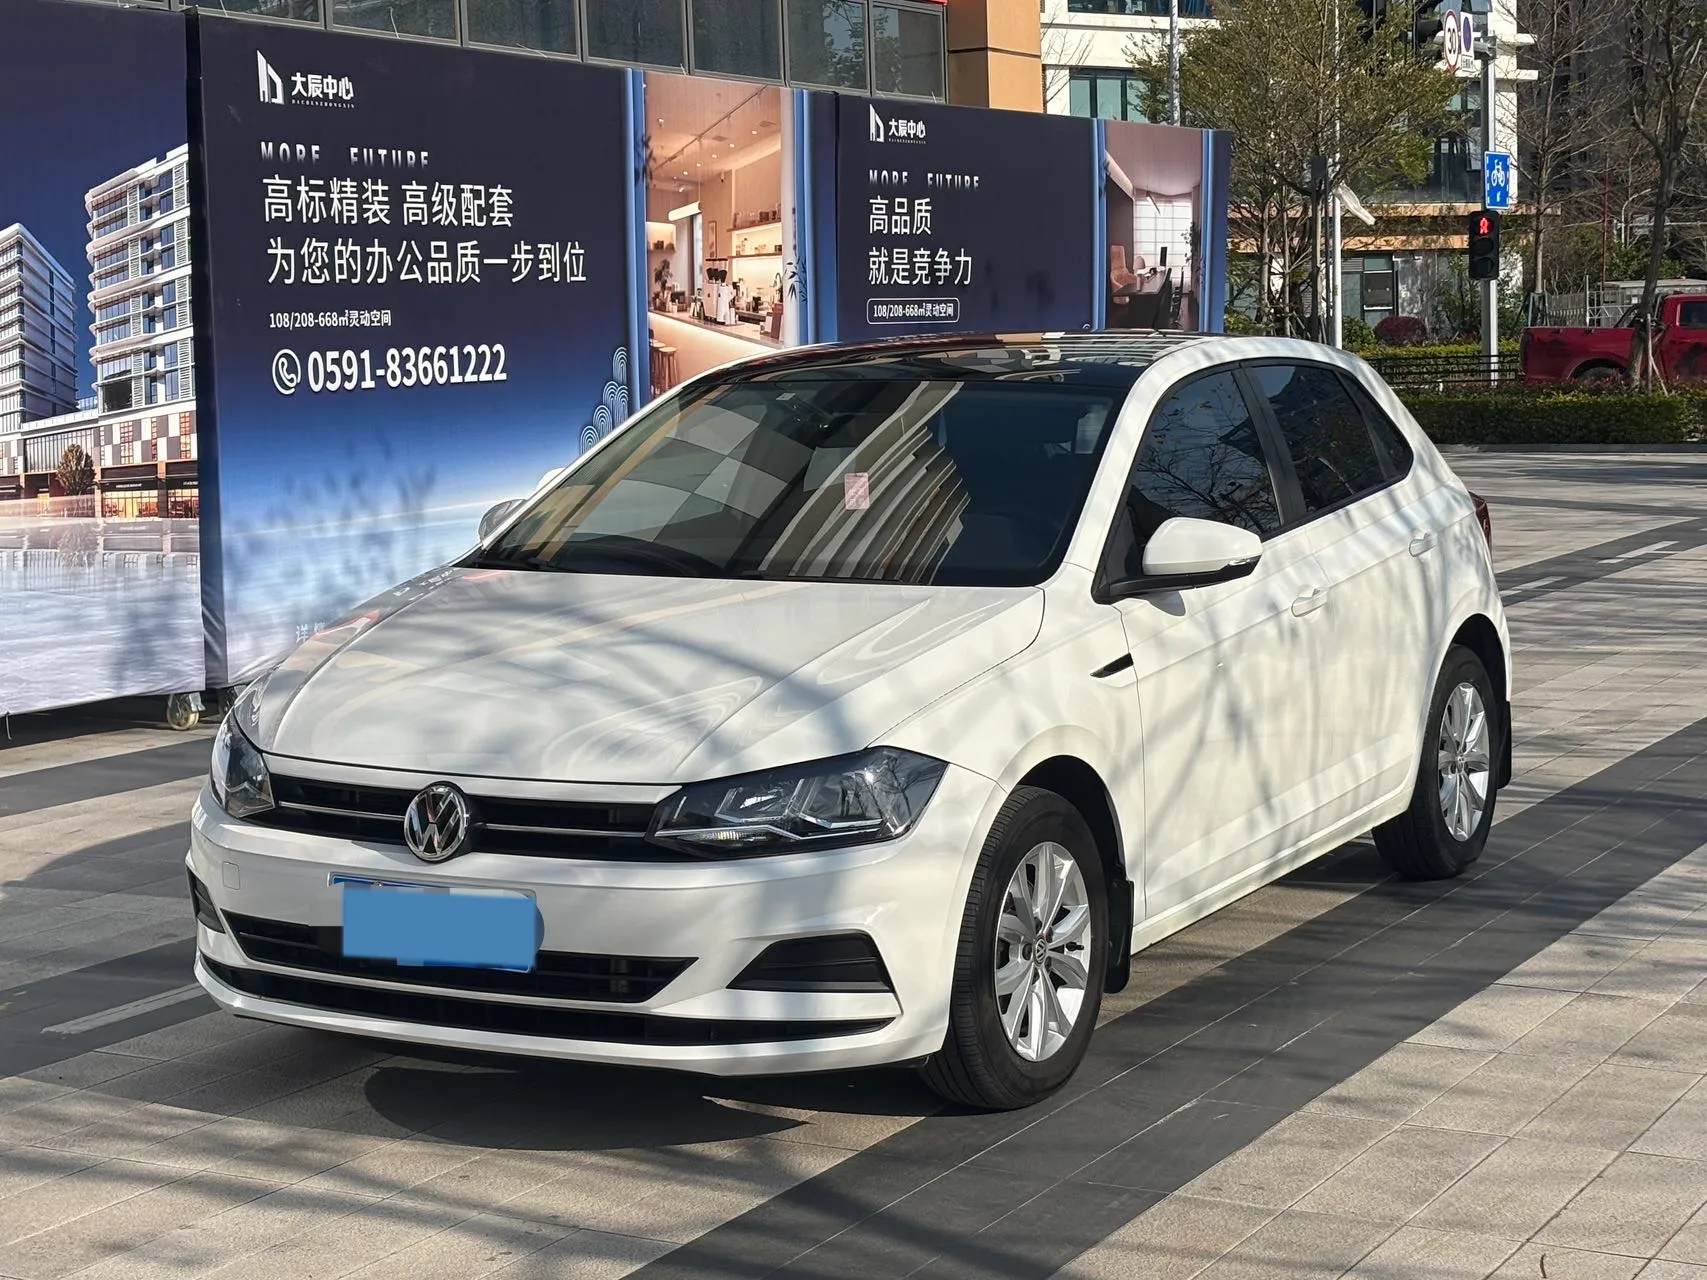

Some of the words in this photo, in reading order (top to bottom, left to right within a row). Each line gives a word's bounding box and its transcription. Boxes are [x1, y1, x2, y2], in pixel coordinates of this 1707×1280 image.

[1447, 27, 1456, 54] 30
[291, 71, 354, 100] 大辰中心
[888, 117, 926, 138] 大辰中心
[262, 174, 391, 225] 高标精装
[401, 180, 514, 227] 高级配套
[869, 195, 932, 235] 高品质
[266, 236, 587, 285] 为您的办公品质一步到位
[868, 246, 972, 286] 就是竞争力
[307, 343, 508, 392] 0591-83661222
